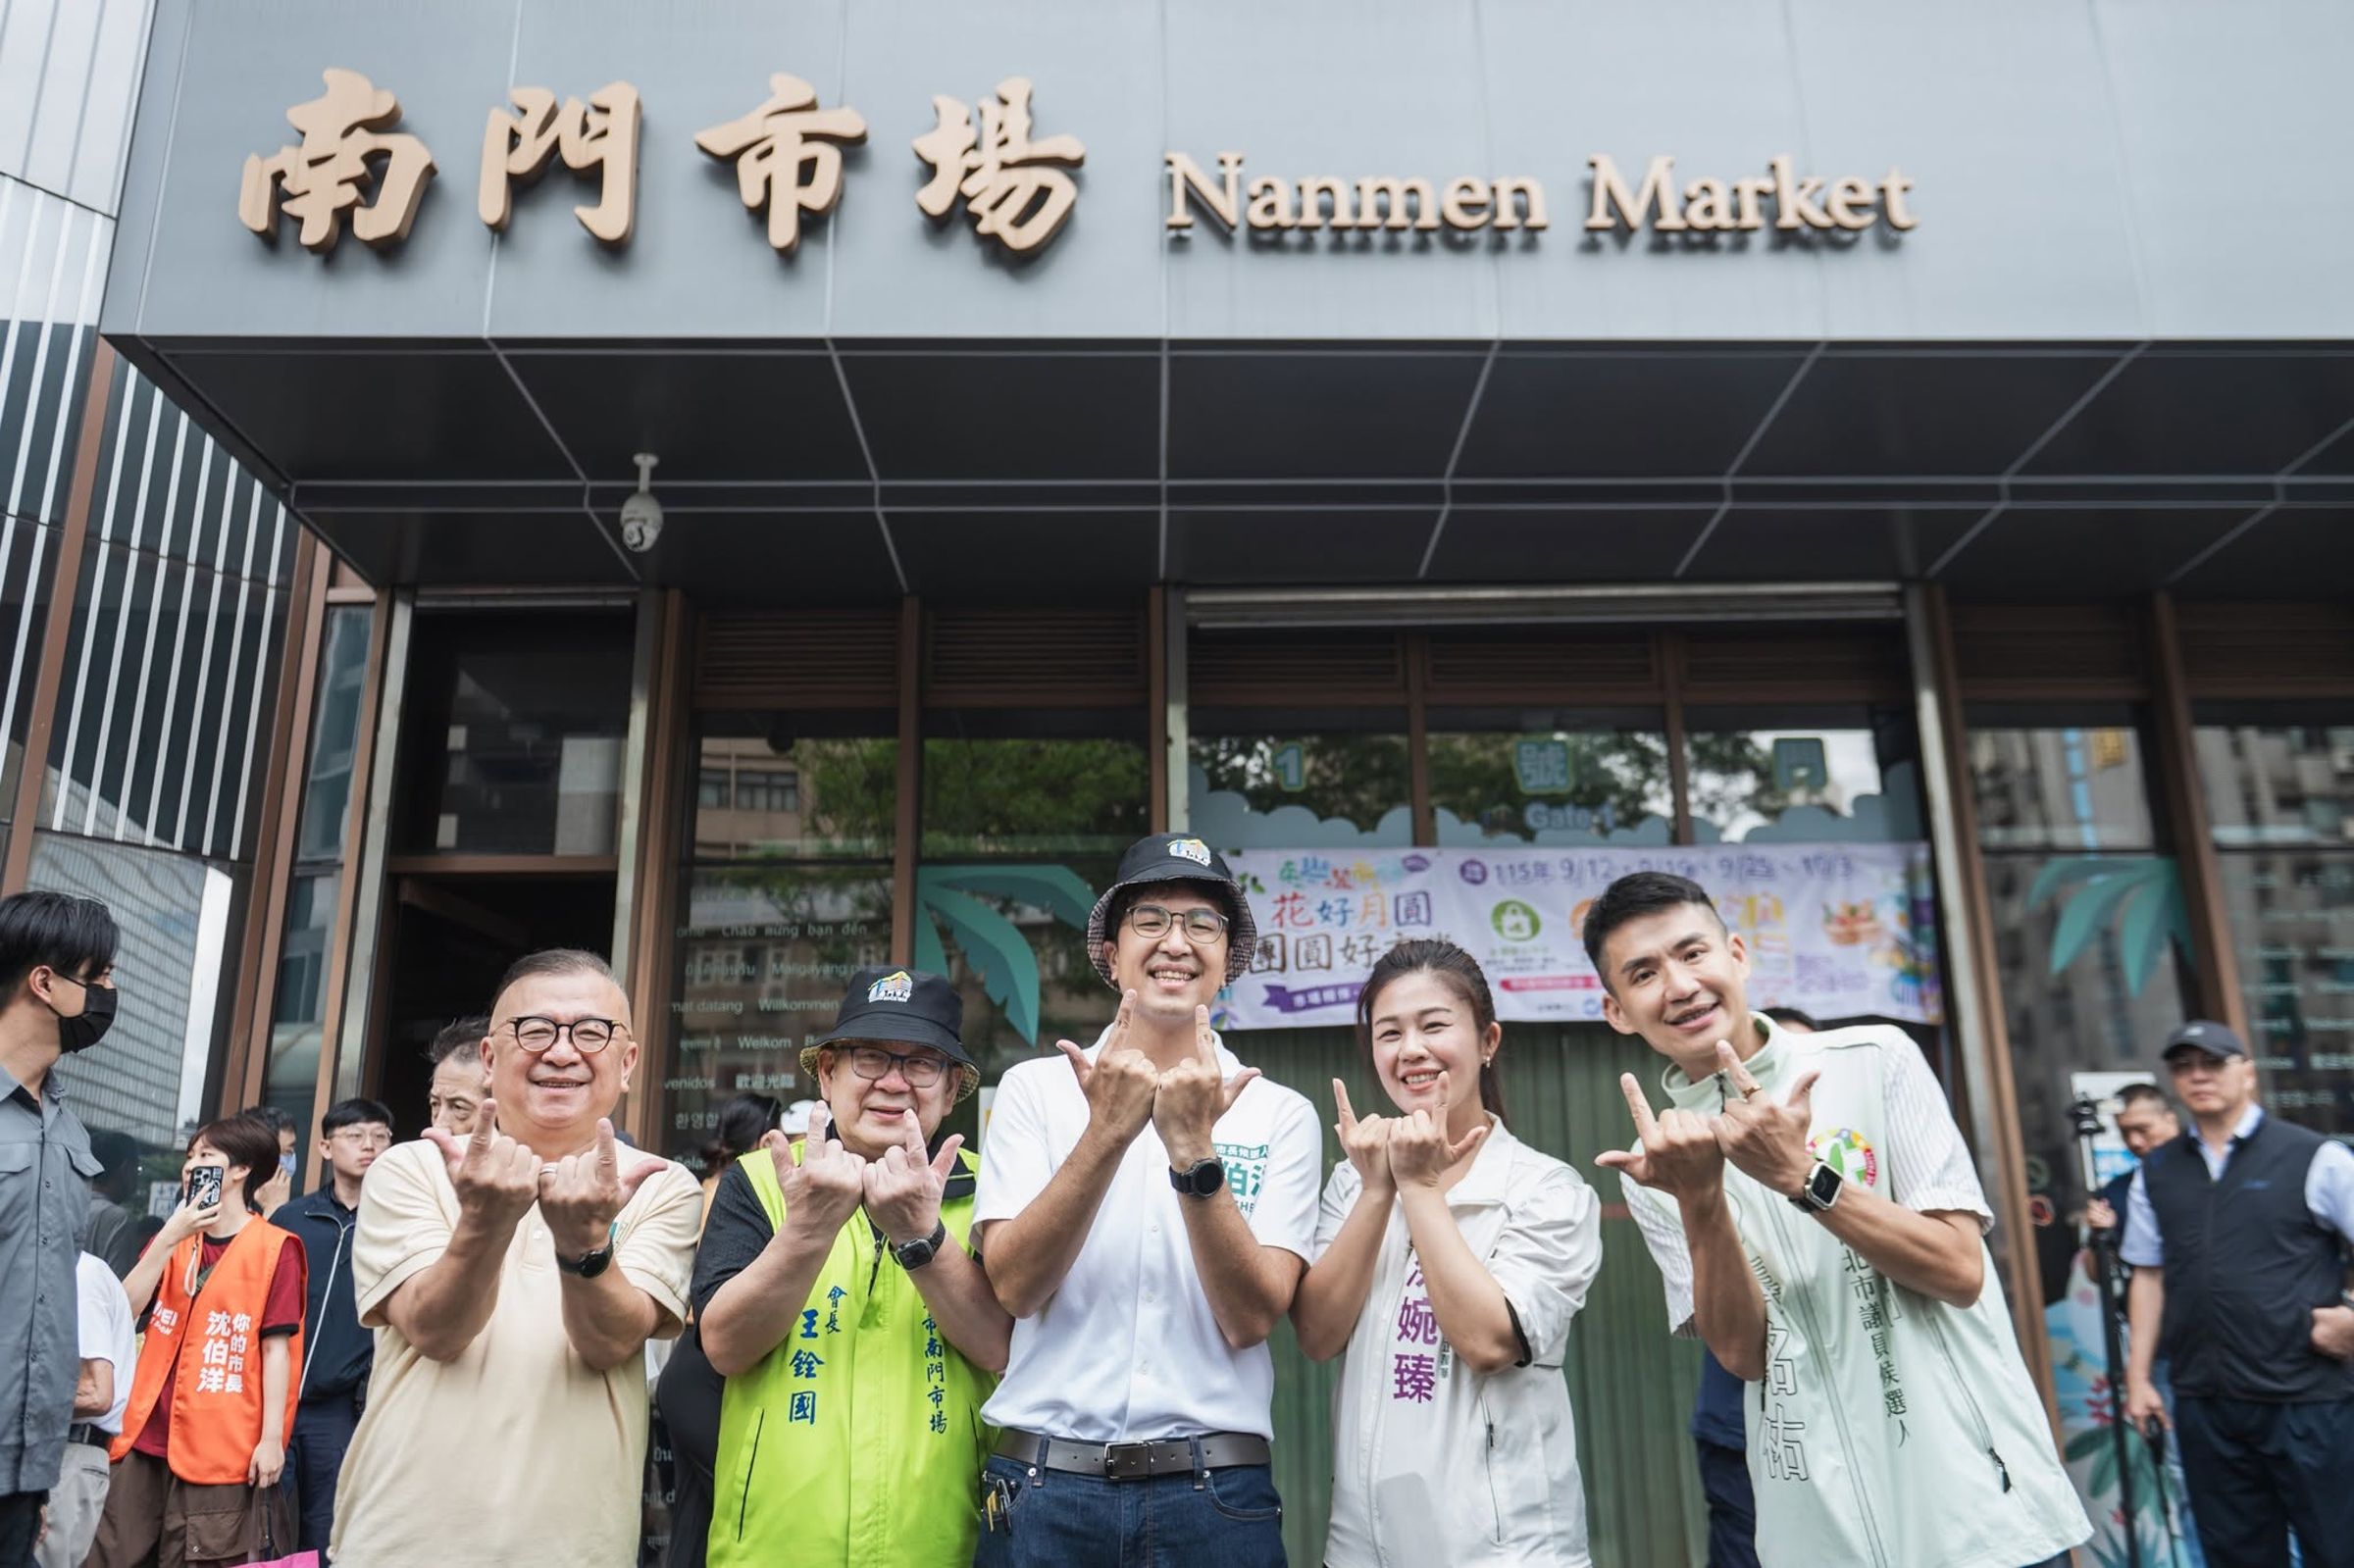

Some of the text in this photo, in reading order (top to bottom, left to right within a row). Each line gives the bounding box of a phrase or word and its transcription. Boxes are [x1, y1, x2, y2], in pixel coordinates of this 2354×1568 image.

[238, 69, 1085, 256] 南門市場
[1165, 151, 1919, 232] Nanmen Market
[1275, 742, 1304, 788] 1
[1525, 801, 1590, 829] Gate
[1272, 890, 1431, 928] 花好月圓
[738, 1035, 792, 1049] Welkom
[825, 1285, 847, 1335] 會長
[1840, 1239, 1910, 1447] 北市議員候選人
[196, 1310, 231, 1392] 沈伯洋
[225, 1313, 251, 1393] 你的市長
[789, 1309, 825, 1425] 王銓國
[921, 1303, 947, 1434] 市南門市場
